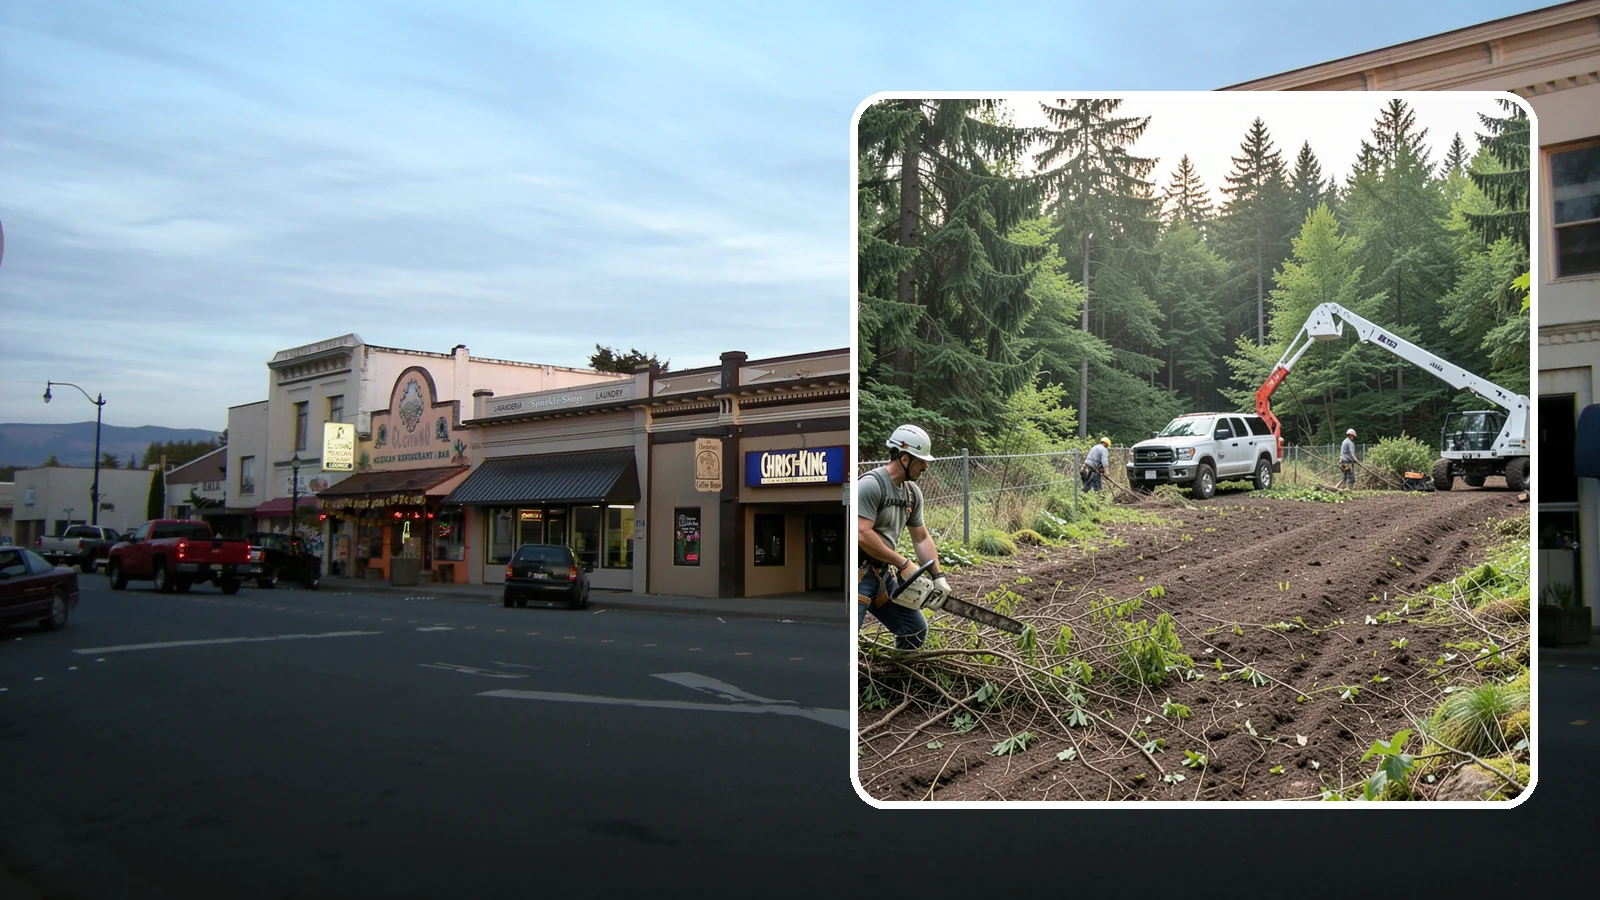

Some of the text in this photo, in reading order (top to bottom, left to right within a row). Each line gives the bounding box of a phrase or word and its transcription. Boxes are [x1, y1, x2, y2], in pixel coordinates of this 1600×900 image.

[562, 394, 582, 404] Shop
[595, 389, 623, 399] LAUNDRY
[493, 402, 522, 412] LAVANDERIA
[374, 450, 450, 464] MEXICAN RESTAURANT BAR
[799, 450, 827, 476] KING
